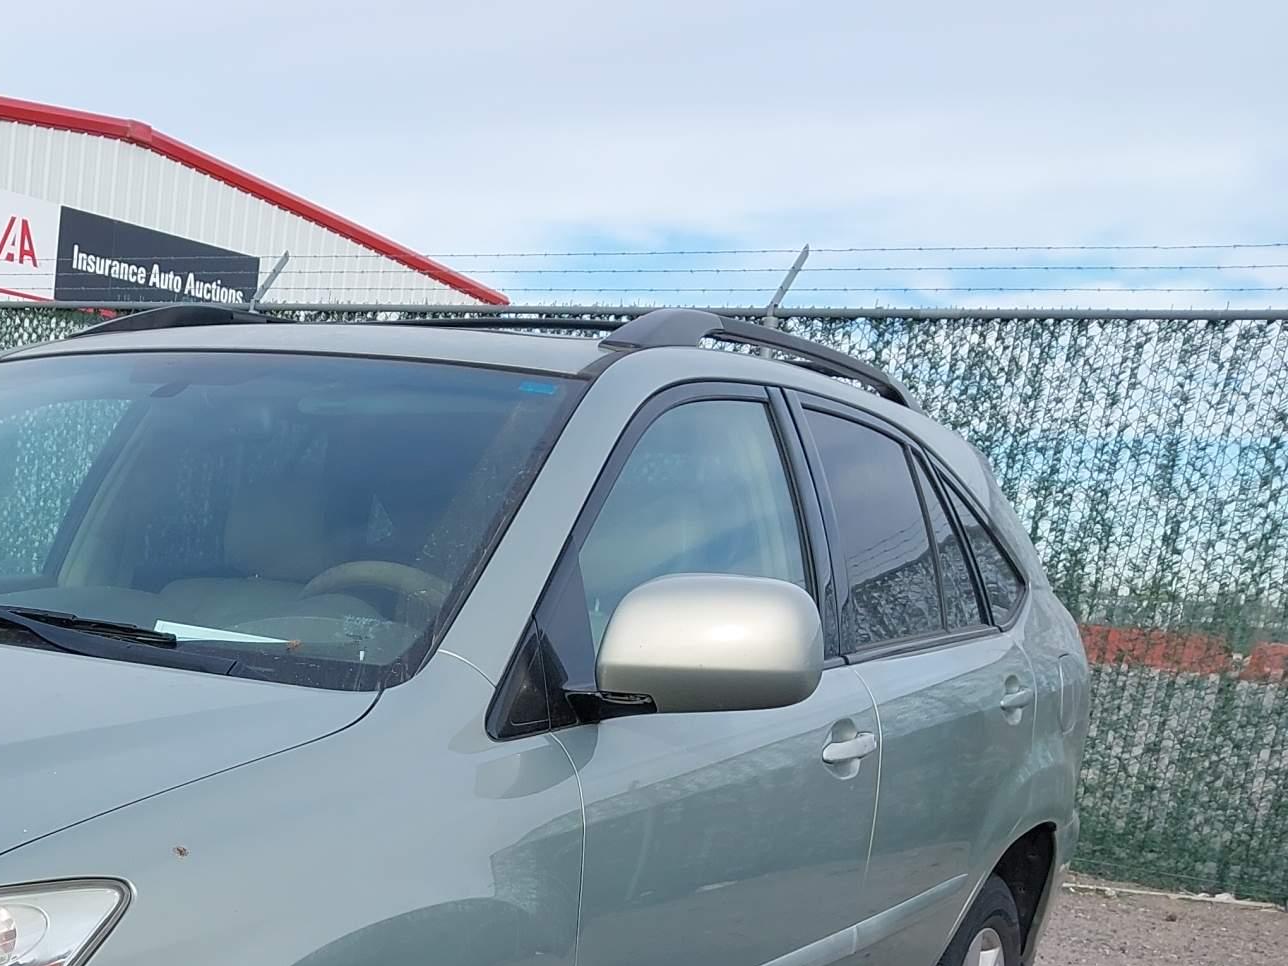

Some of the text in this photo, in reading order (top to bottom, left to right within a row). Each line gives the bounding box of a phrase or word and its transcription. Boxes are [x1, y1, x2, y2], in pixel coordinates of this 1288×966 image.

[72, 244, 244, 304] Insurance Auto Auctions
